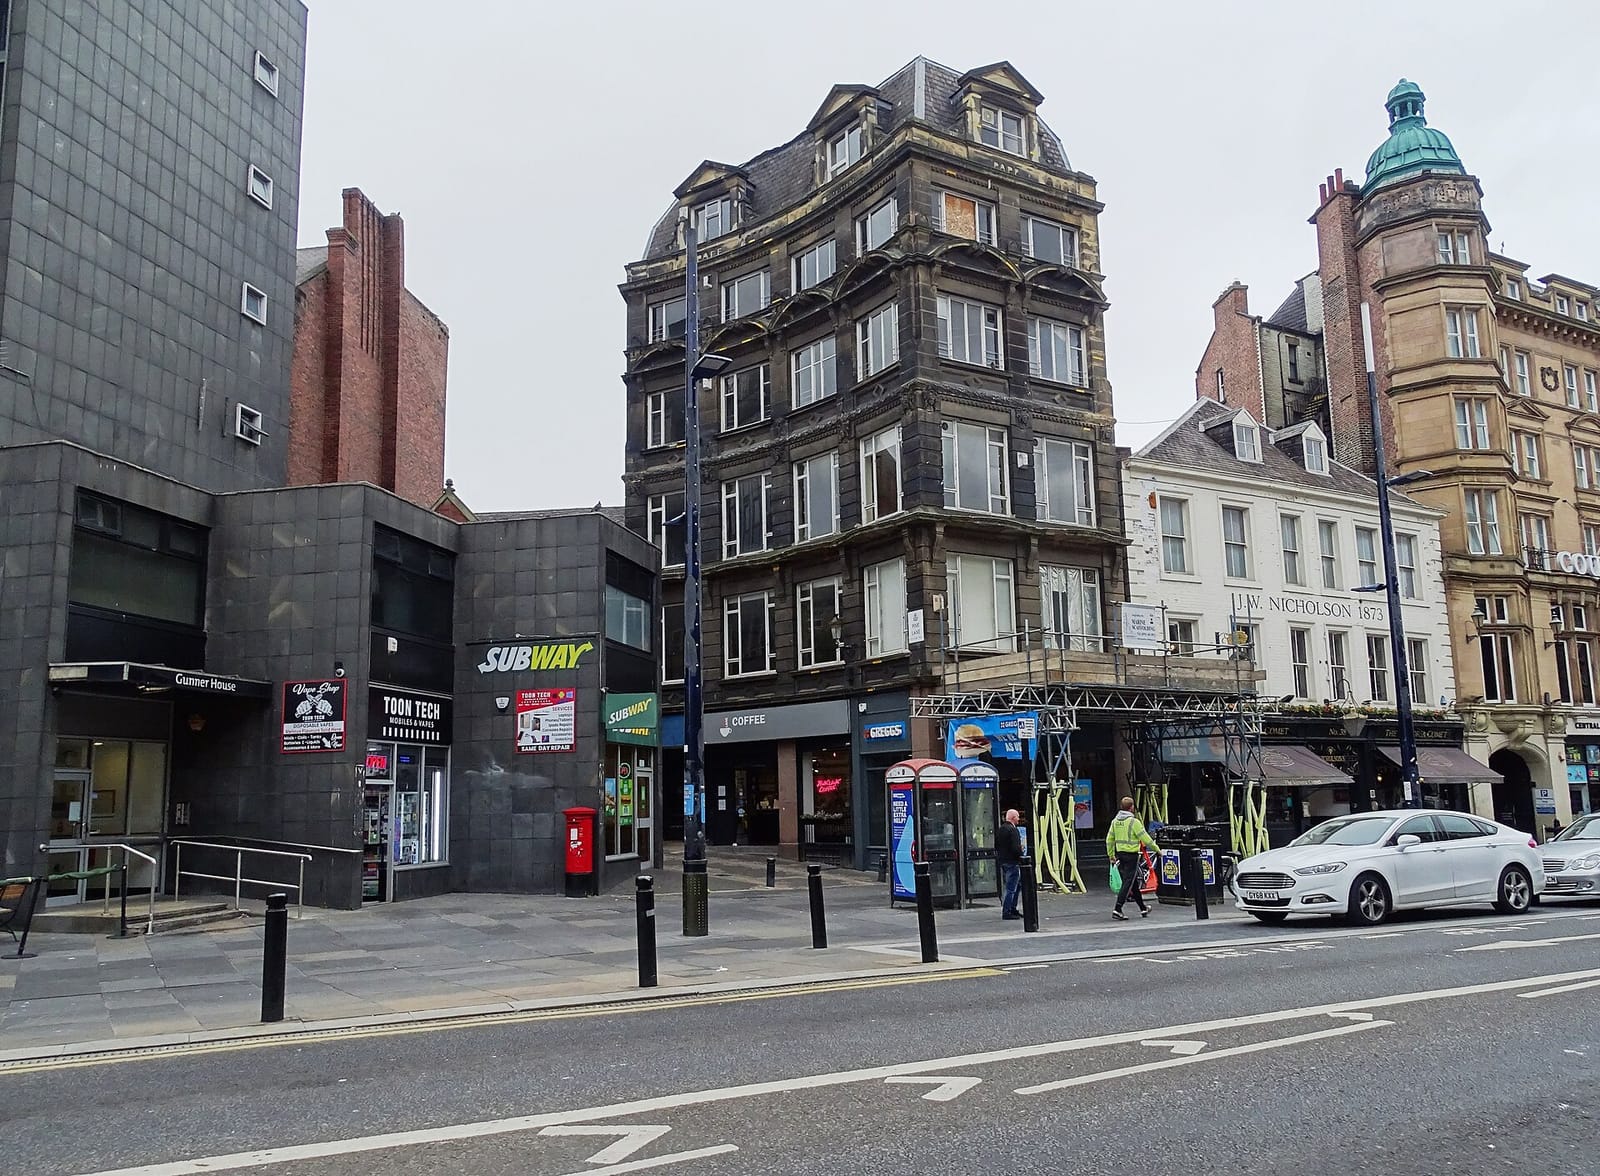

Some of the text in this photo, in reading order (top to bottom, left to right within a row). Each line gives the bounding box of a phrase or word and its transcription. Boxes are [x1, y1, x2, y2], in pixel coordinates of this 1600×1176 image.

[1237, 594, 1384, 621] J.W. NICHOLSON 1873
[478, 641, 594, 674] SUBWAY
[175, 673, 236, 691] Gunner House
[292, 682, 340, 695] Vape Shop
[384, 696, 440, 720] TOON TECH
[608, 697, 652, 724] SUBWAY
[389, 716, 434, 728] MOBILES & VAPES
[732, 714, 766, 726] COFFEE
[870, 724, 903, 738] GREGGS
